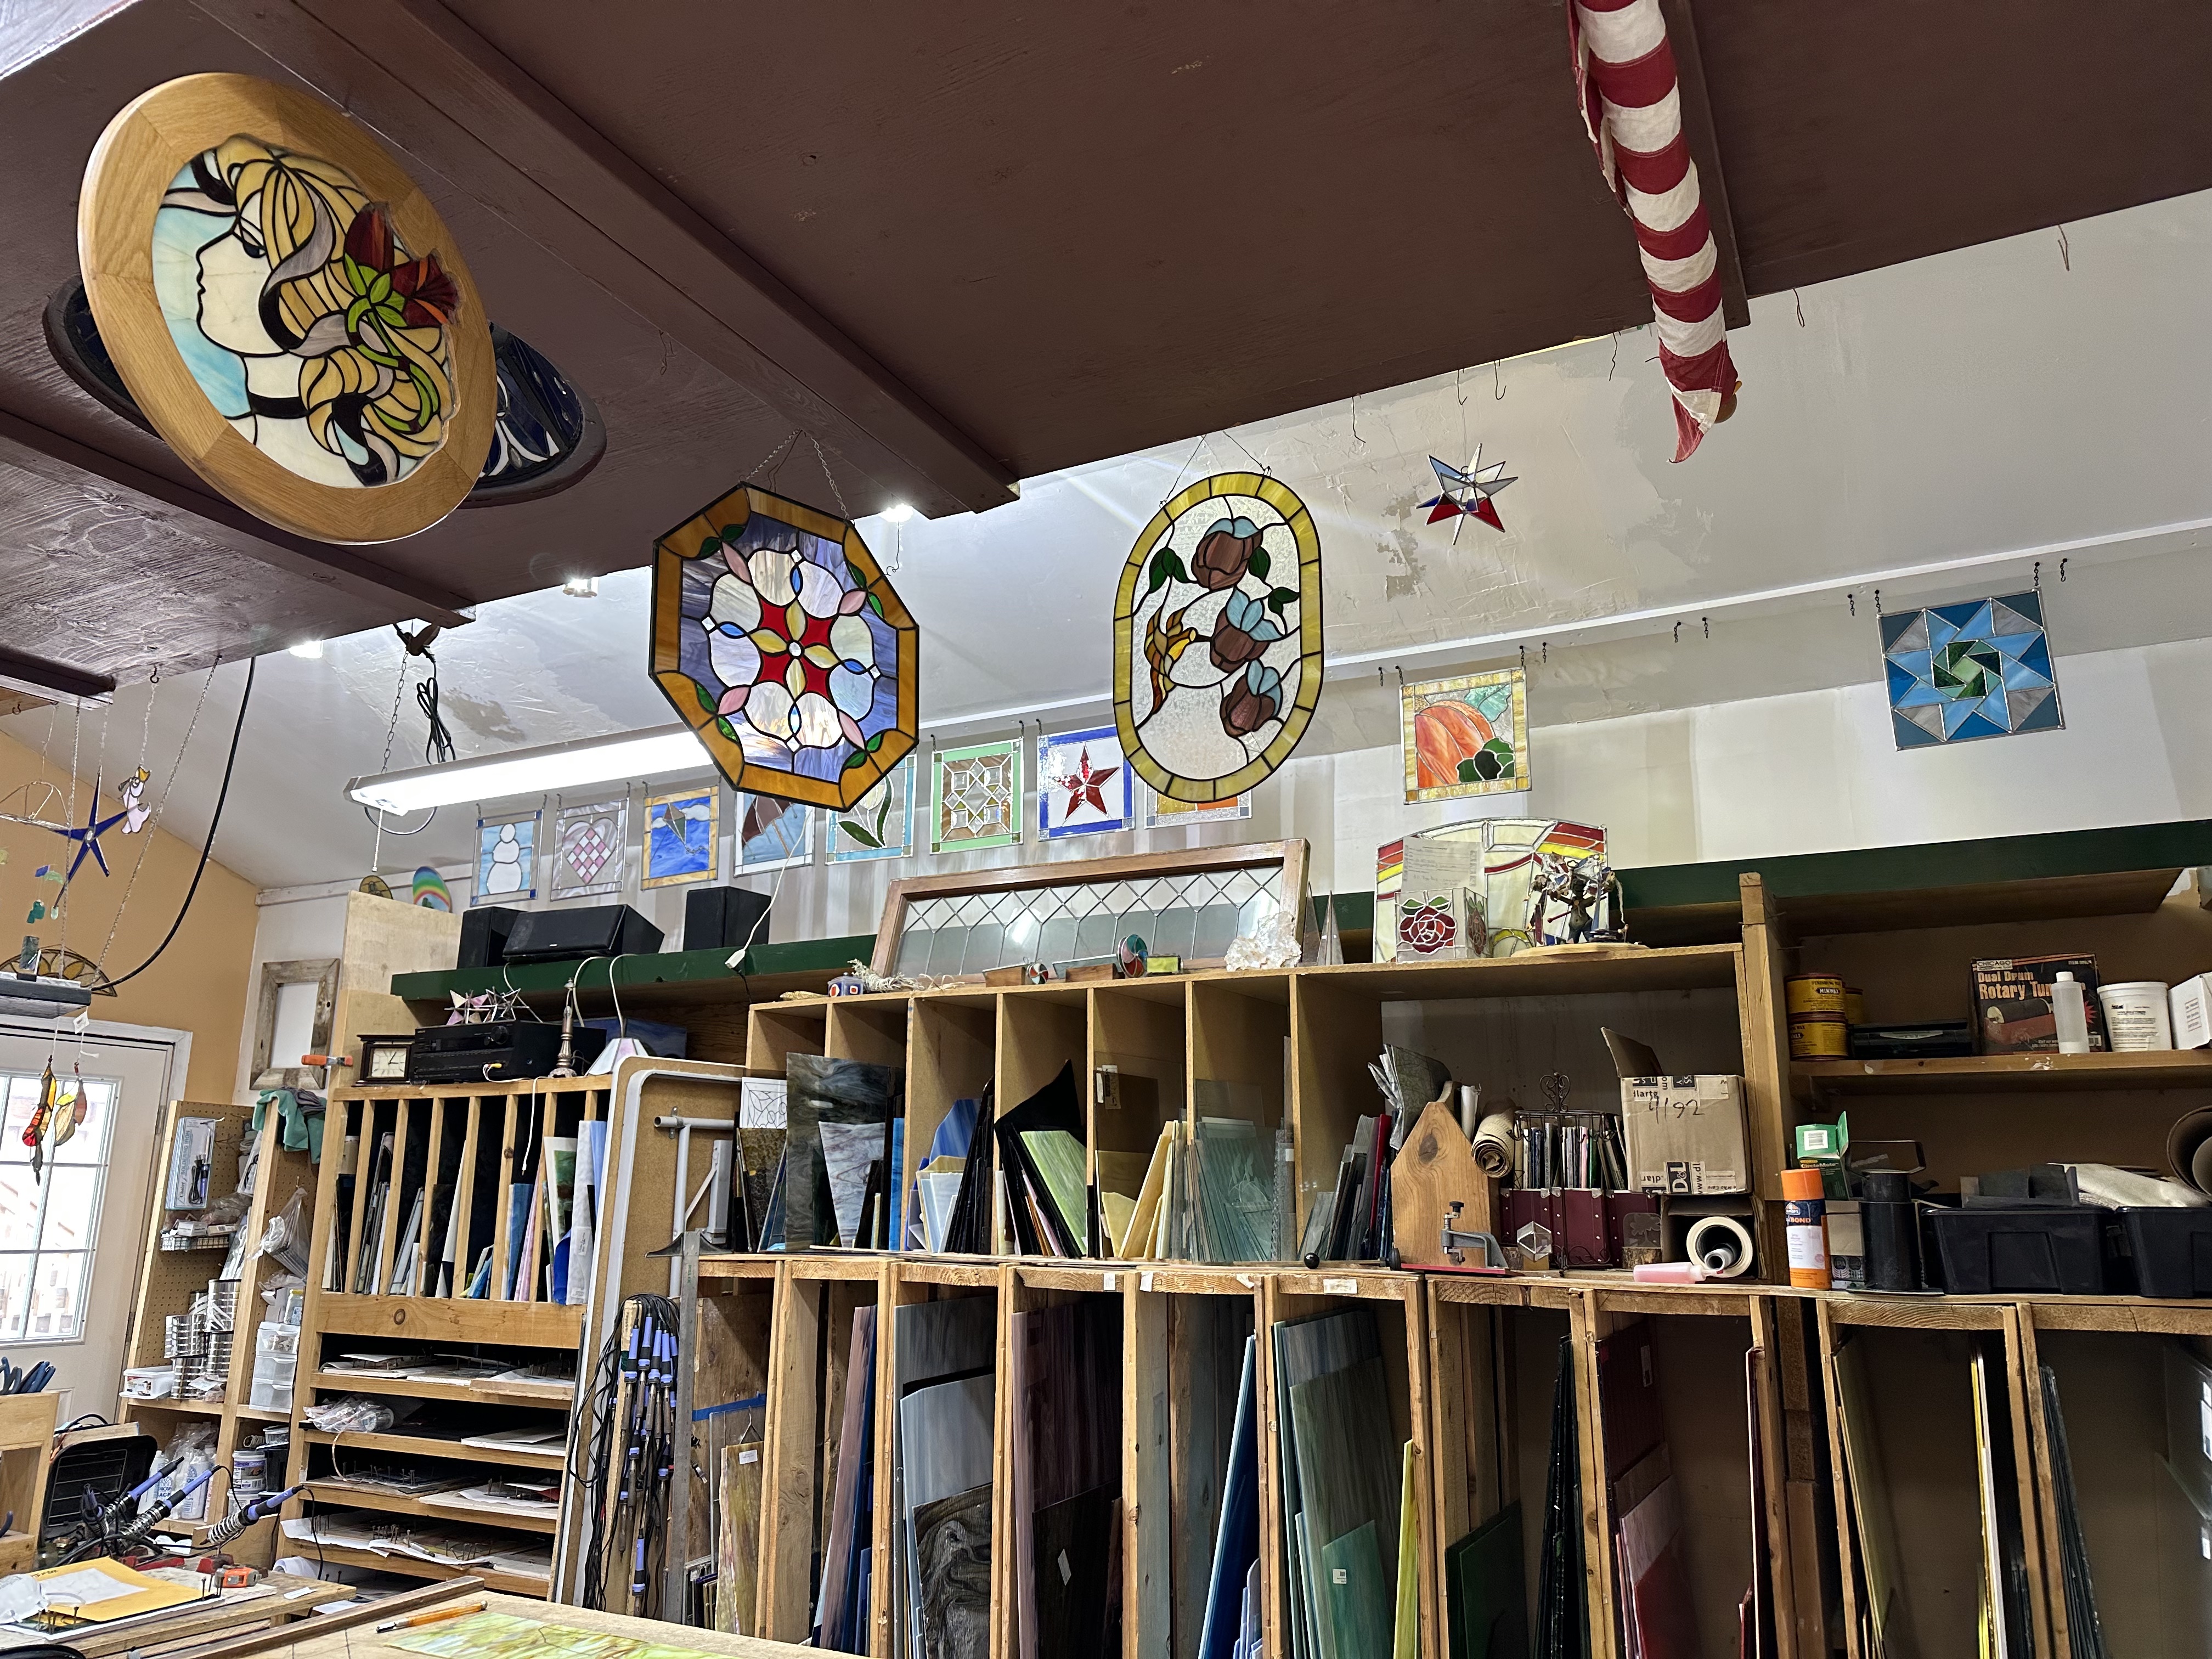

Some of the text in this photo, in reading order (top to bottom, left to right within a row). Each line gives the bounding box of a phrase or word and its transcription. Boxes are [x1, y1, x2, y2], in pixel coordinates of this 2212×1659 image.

[1978, 971, 2034, 983] Dual Drum
[1979, 983, 2025, 1000] Rotary
[180, 1144, 189, 1175] SOLDERING
[1670, 1162, 1689, 1193] D&L
